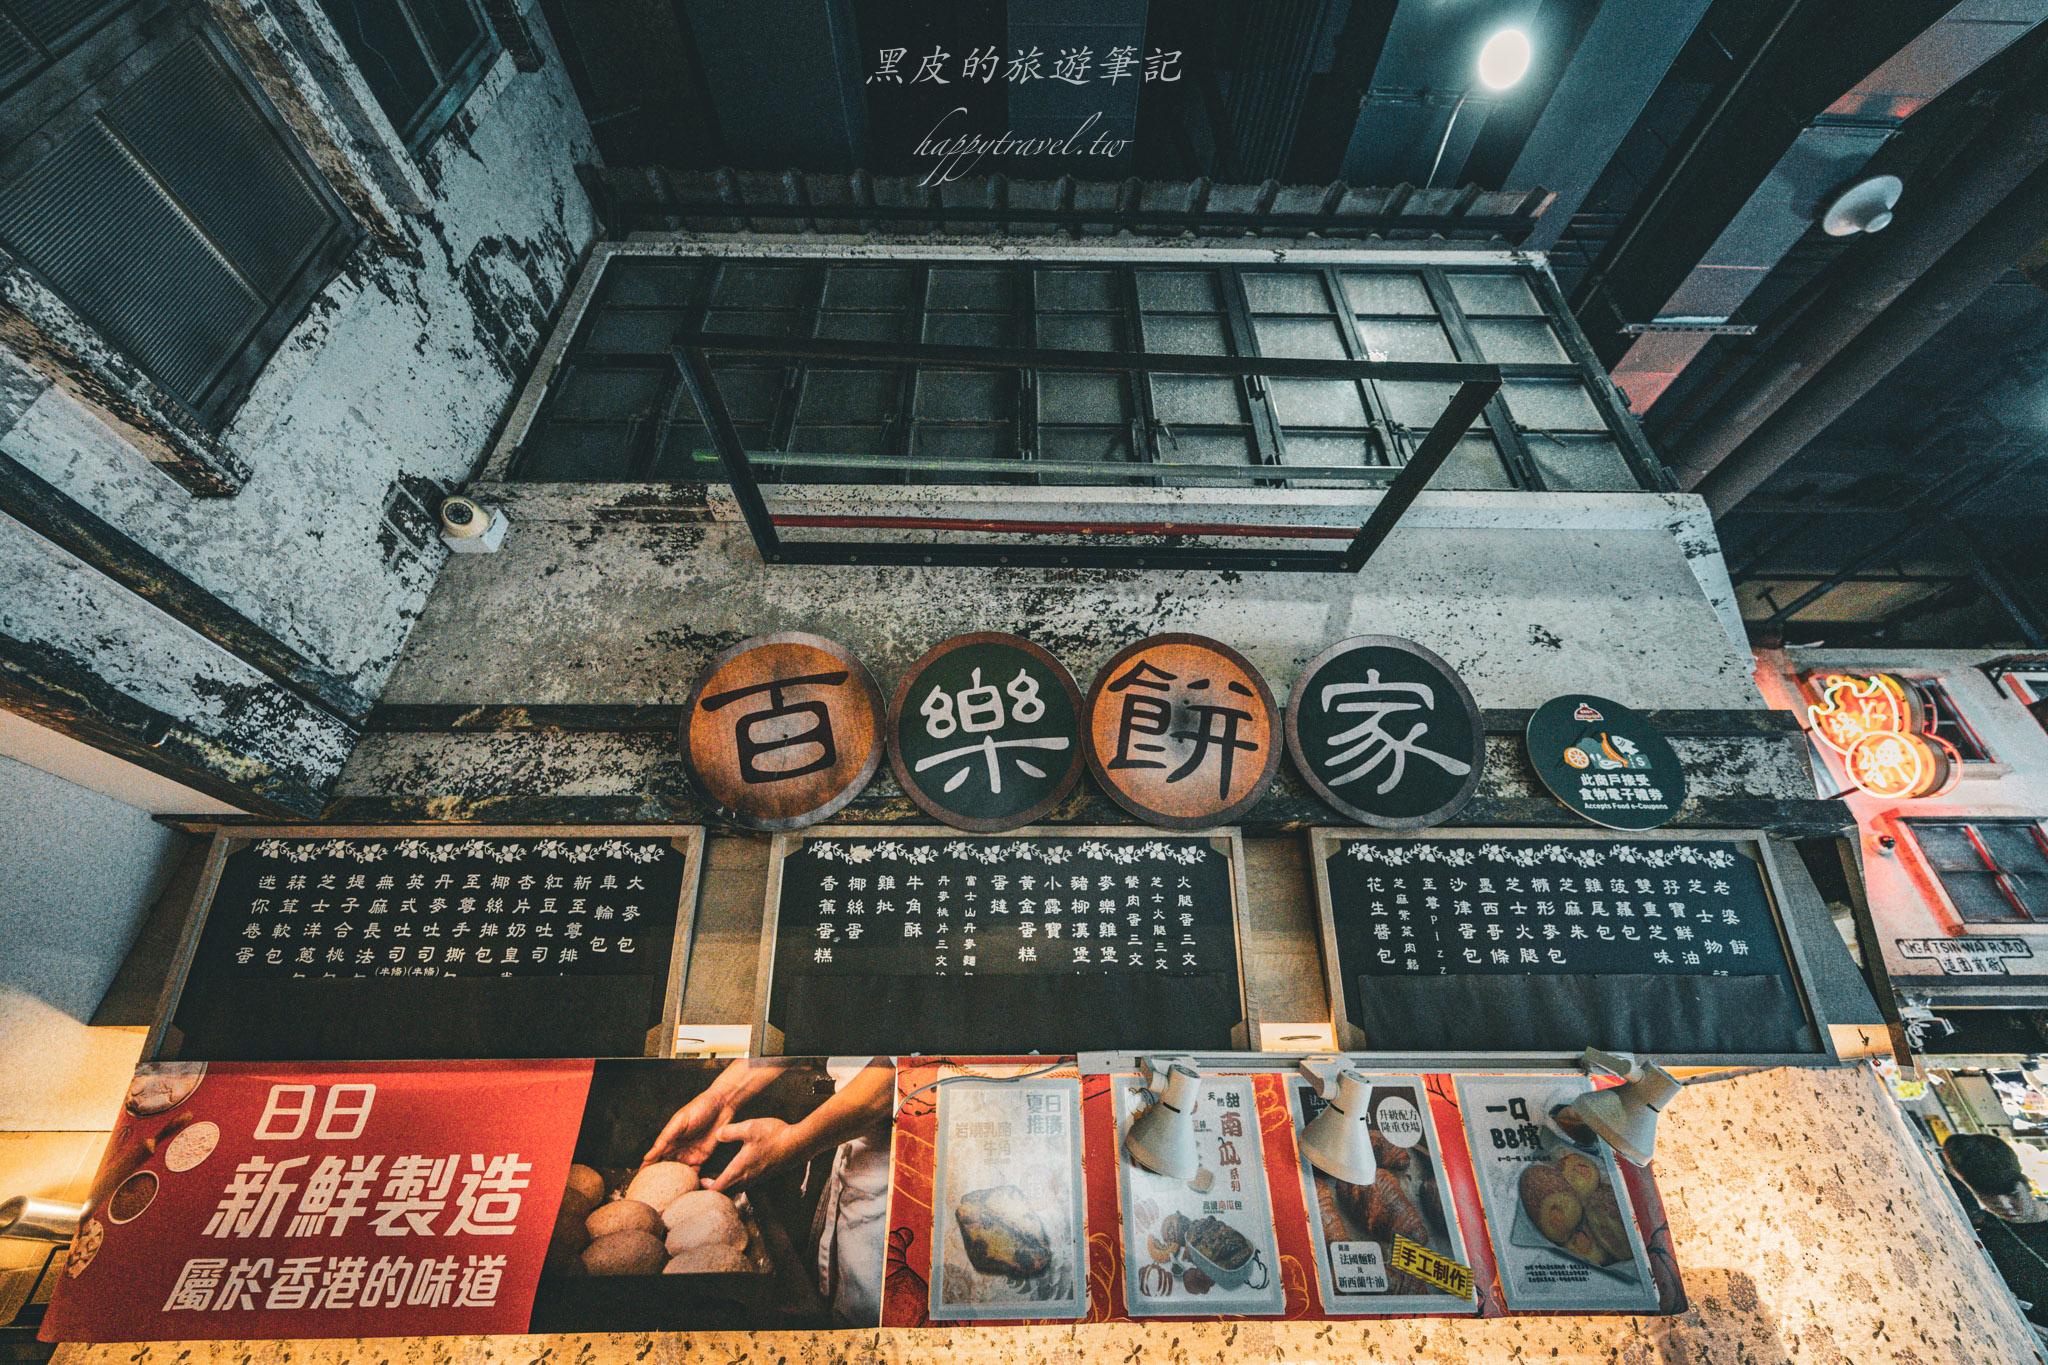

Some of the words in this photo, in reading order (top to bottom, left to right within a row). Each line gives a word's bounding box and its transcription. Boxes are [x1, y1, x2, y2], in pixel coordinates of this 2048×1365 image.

[701, 658, 1471, 799] 百樂餅家
[531, 874, 564, 964] 紅豆吐司
[558, 875, 592, 977] 新至尊排
[589, 875, 618, 953] 車輪包
[616, 876, 645, 953] 大麥包
[813, 875, 839, 964] 香蕉蛋糕
[903, 875, 924, 939] 牛角酥
[935, 875, 950, 976] 丹麥桃片三文
[1070, 876, 1091, 975] 豬柳漢堡
[1098, 876, 1119, 975] 麥樂雞堡
[1177, 876, 1198, 975] 火腿蛋三文
[1505, 877, 1540, 975] 芝士火腿
[1713, 880, 1749, 956] 老婆餅
[253, 1084, 376, 1140] 日日
[202, 1154, 532, 1238] 新鮮製造
[162, 1255, 507, 1312] 屬於香港的味道
[1400, 1246, 1468, 1291] 手工制作
